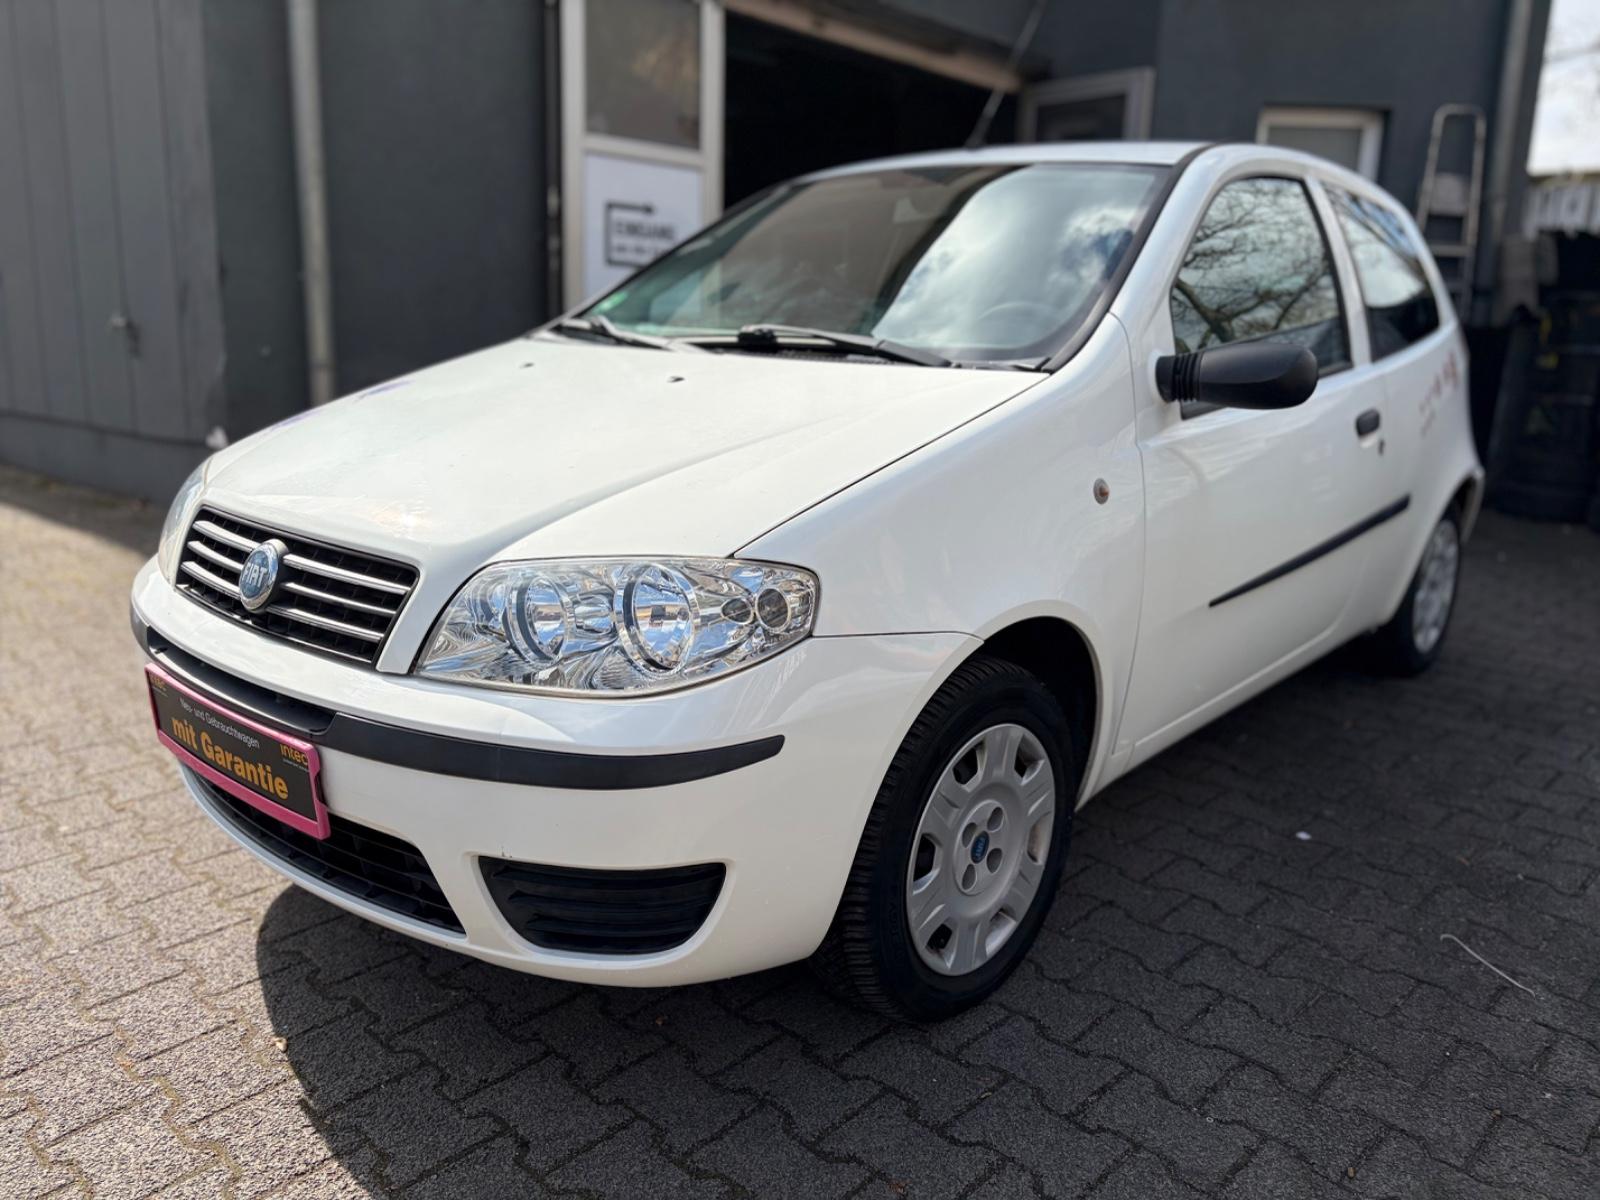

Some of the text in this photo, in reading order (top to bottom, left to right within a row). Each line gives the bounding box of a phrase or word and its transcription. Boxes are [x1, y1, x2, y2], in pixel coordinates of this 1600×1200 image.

[242, 562, 267, 587] FIAT
[194, 708, 205, 721] und
[205, 712, 260, 749] Gebrauchtwagen
[171, 717, 288, 800] mit Garantie
